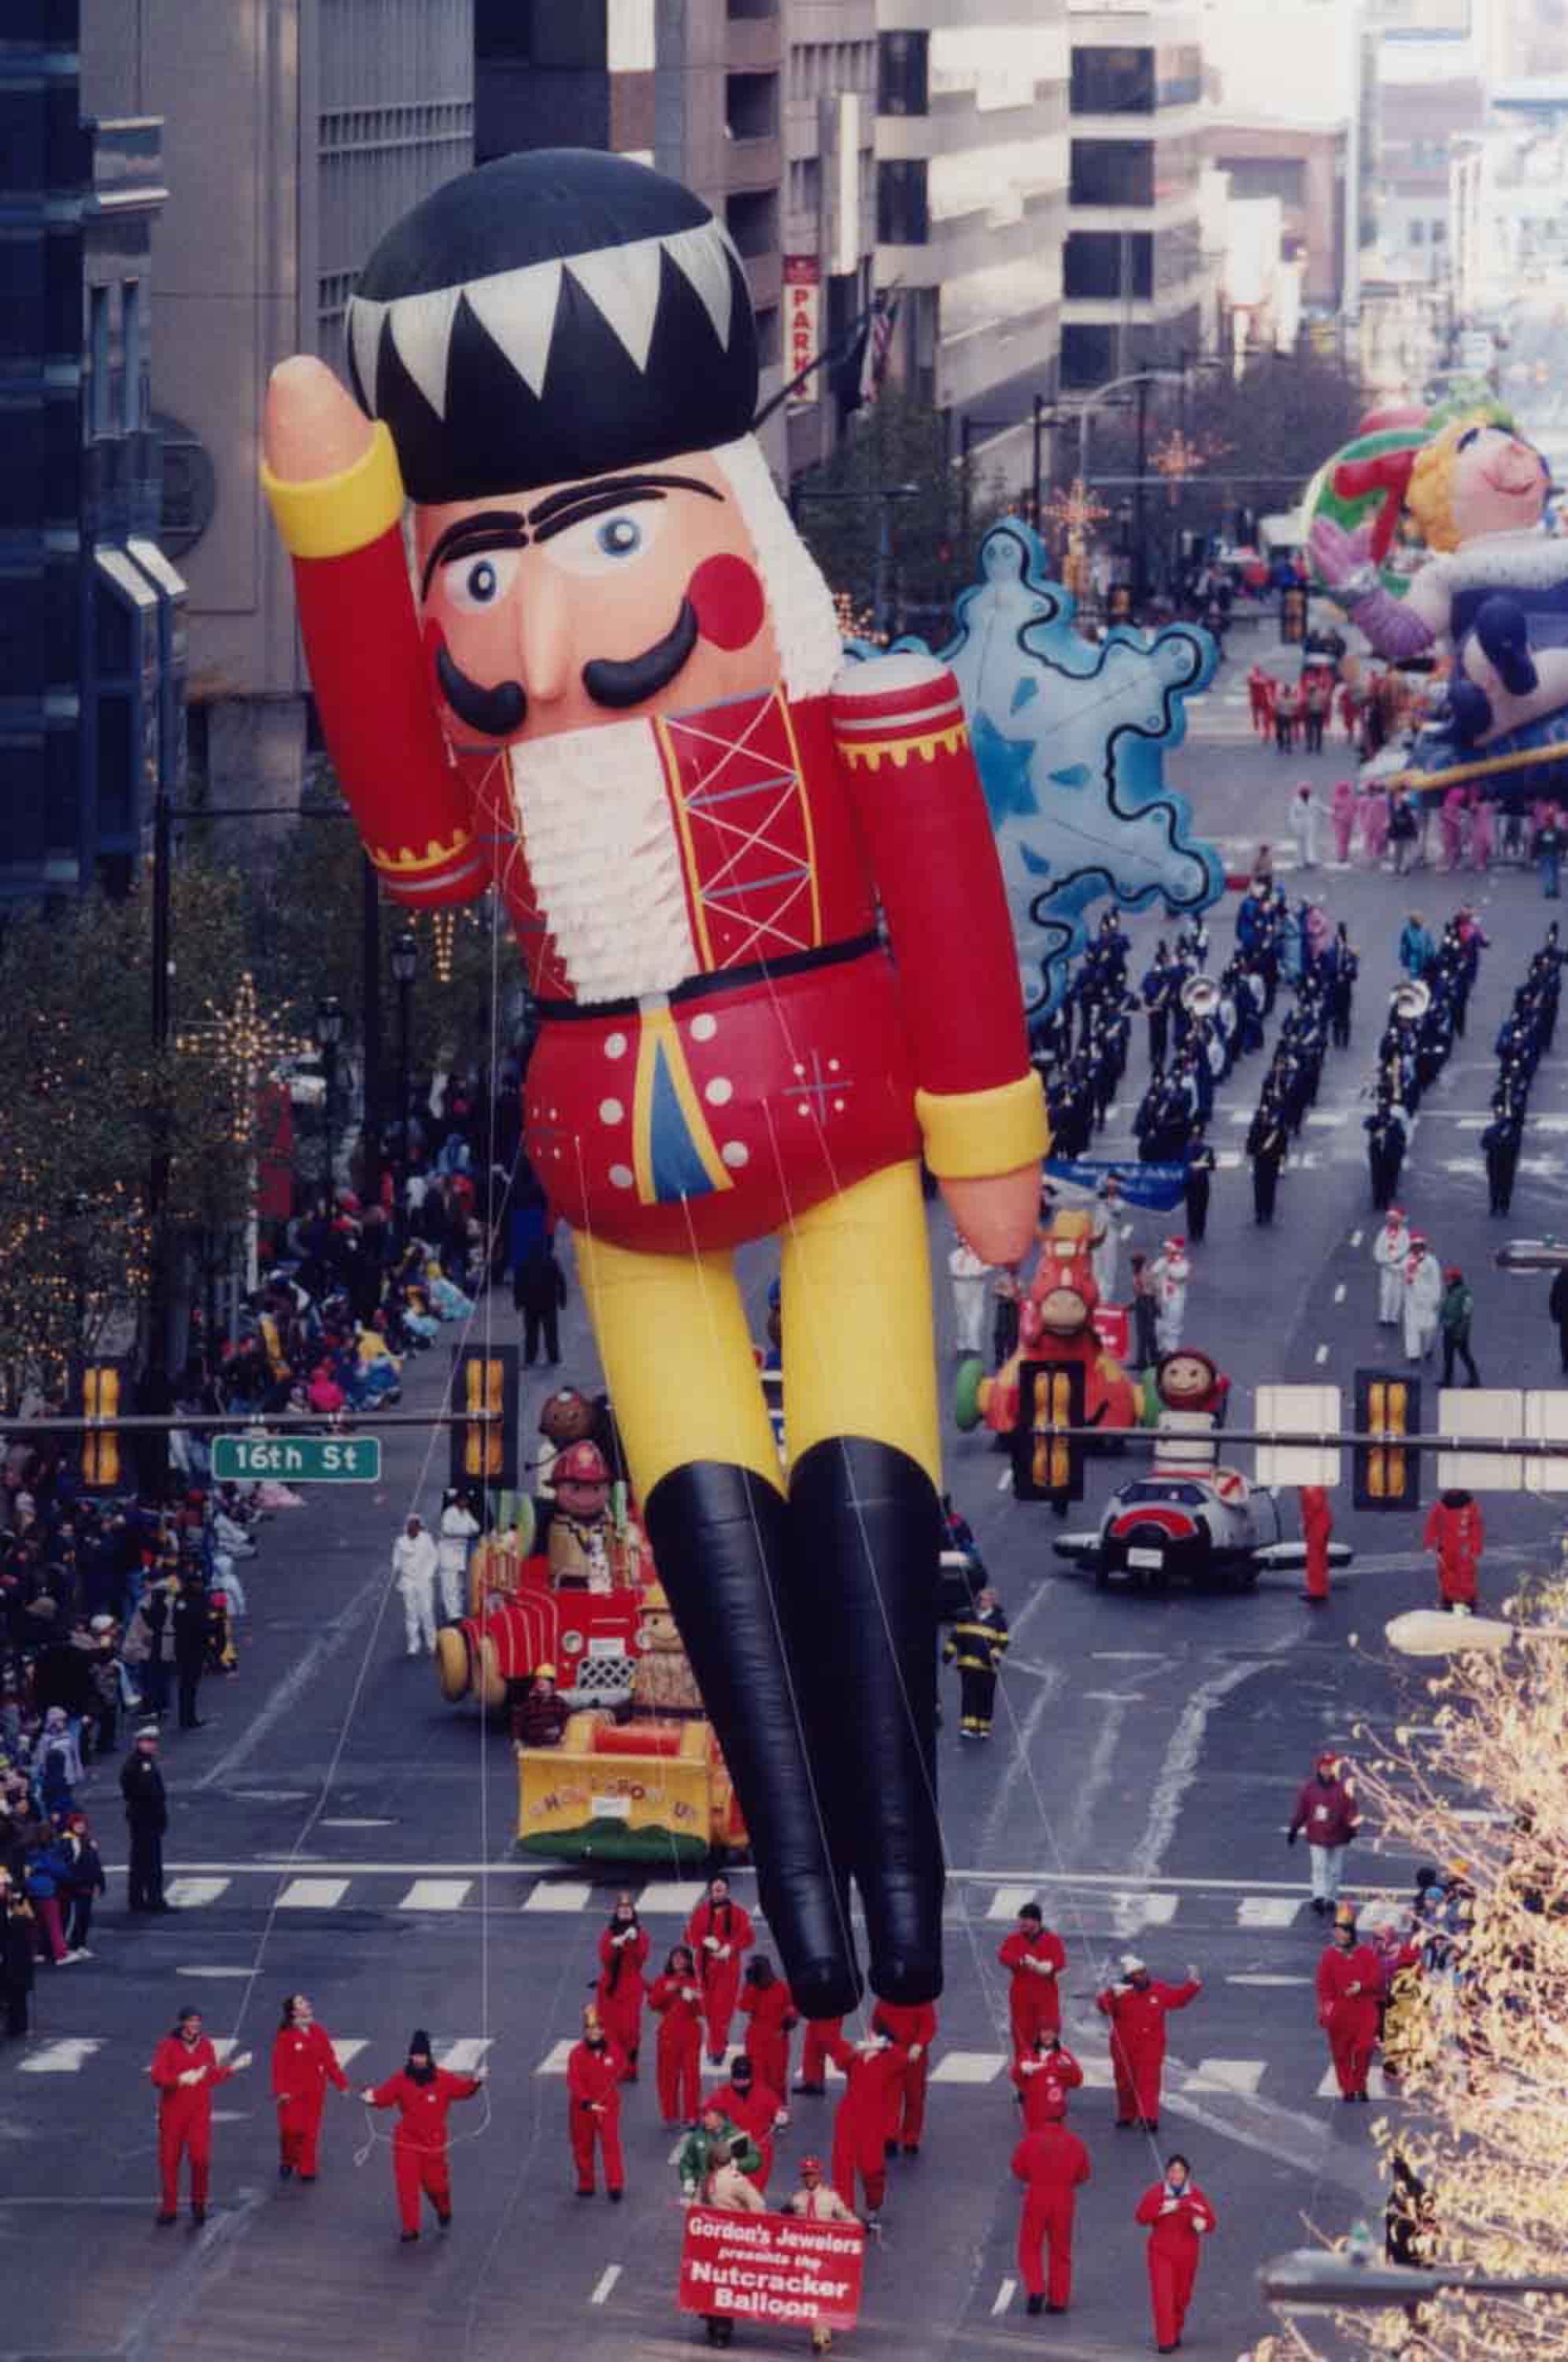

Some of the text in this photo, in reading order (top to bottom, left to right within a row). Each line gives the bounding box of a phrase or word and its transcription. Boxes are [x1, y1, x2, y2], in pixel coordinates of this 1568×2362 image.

[792, 288, 809, 373] PARK
[236, 1444, 357, 1472] 16th St
[689, 2216, 861, 2254] Gordon's Jewelers
[690, 2260, 849, 2298] Nutcracker
[715, 2287, 819, 2318] Balloon
